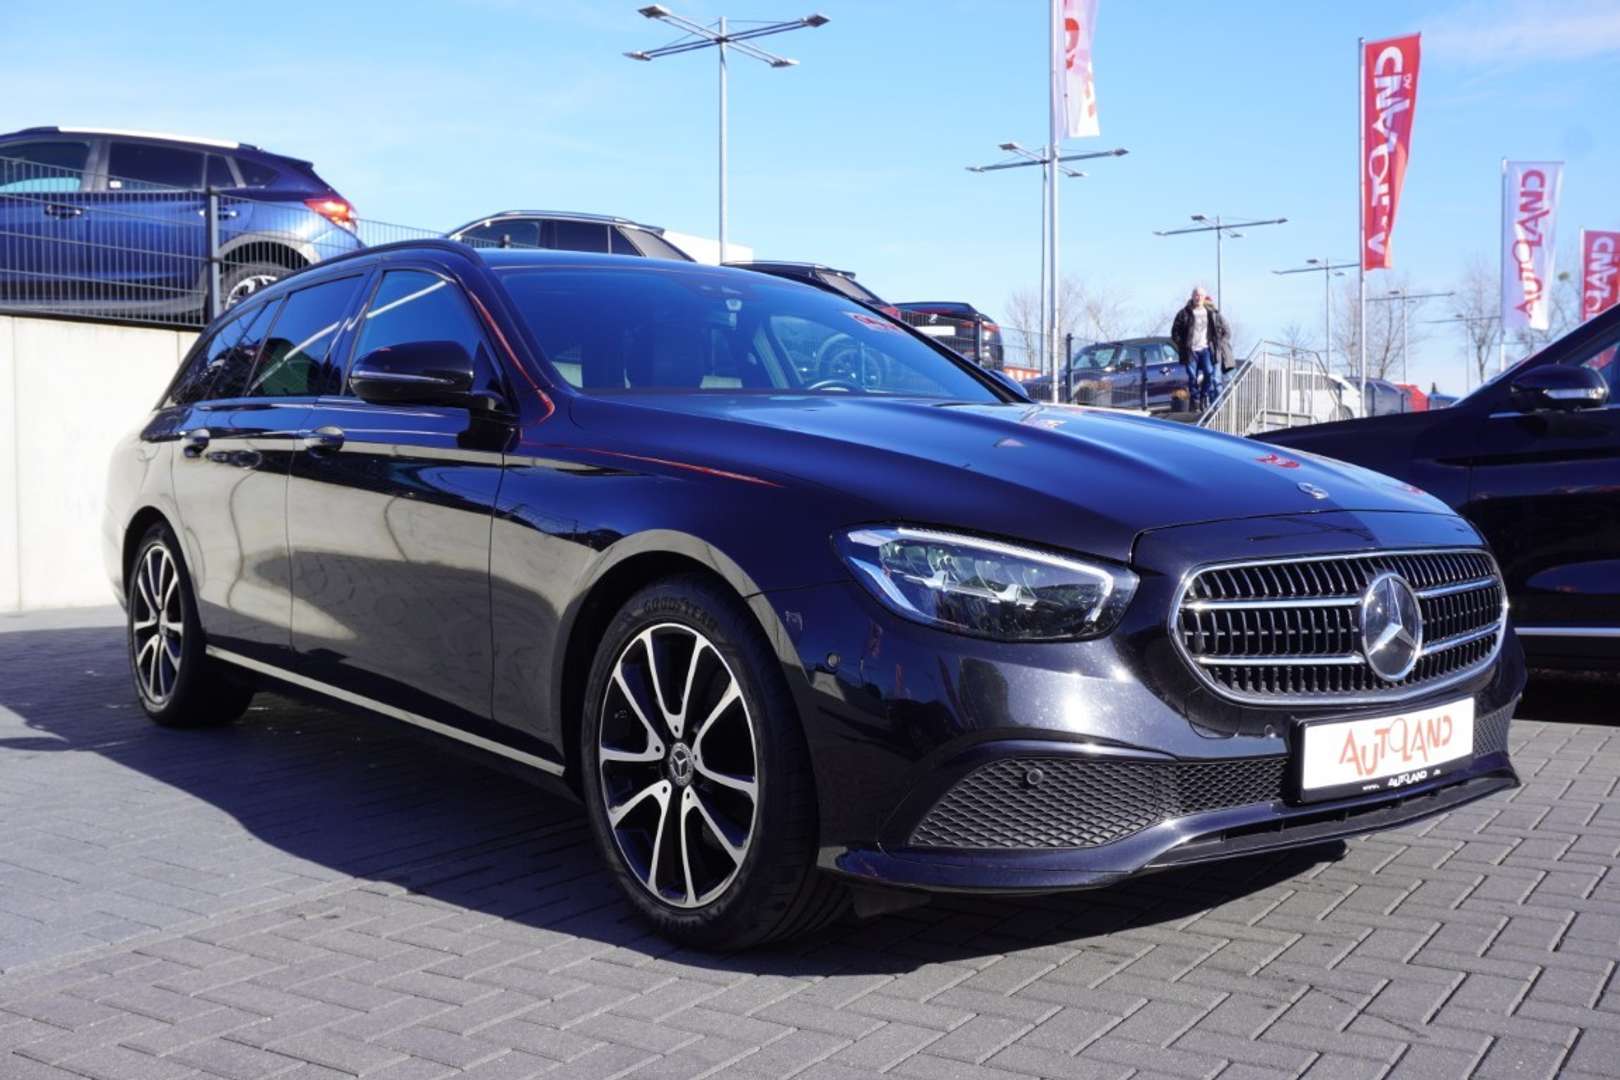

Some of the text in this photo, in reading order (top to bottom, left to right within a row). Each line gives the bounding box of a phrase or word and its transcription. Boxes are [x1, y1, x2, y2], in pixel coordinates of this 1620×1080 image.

[1511, 169, 1550, 319] AUTOLAND
[1585, 236, 1617, 320] OLAND
[1339, 714, 1453, 776] AUTOLAND
[1387, 771, 1427, 787] AUTOLAND
